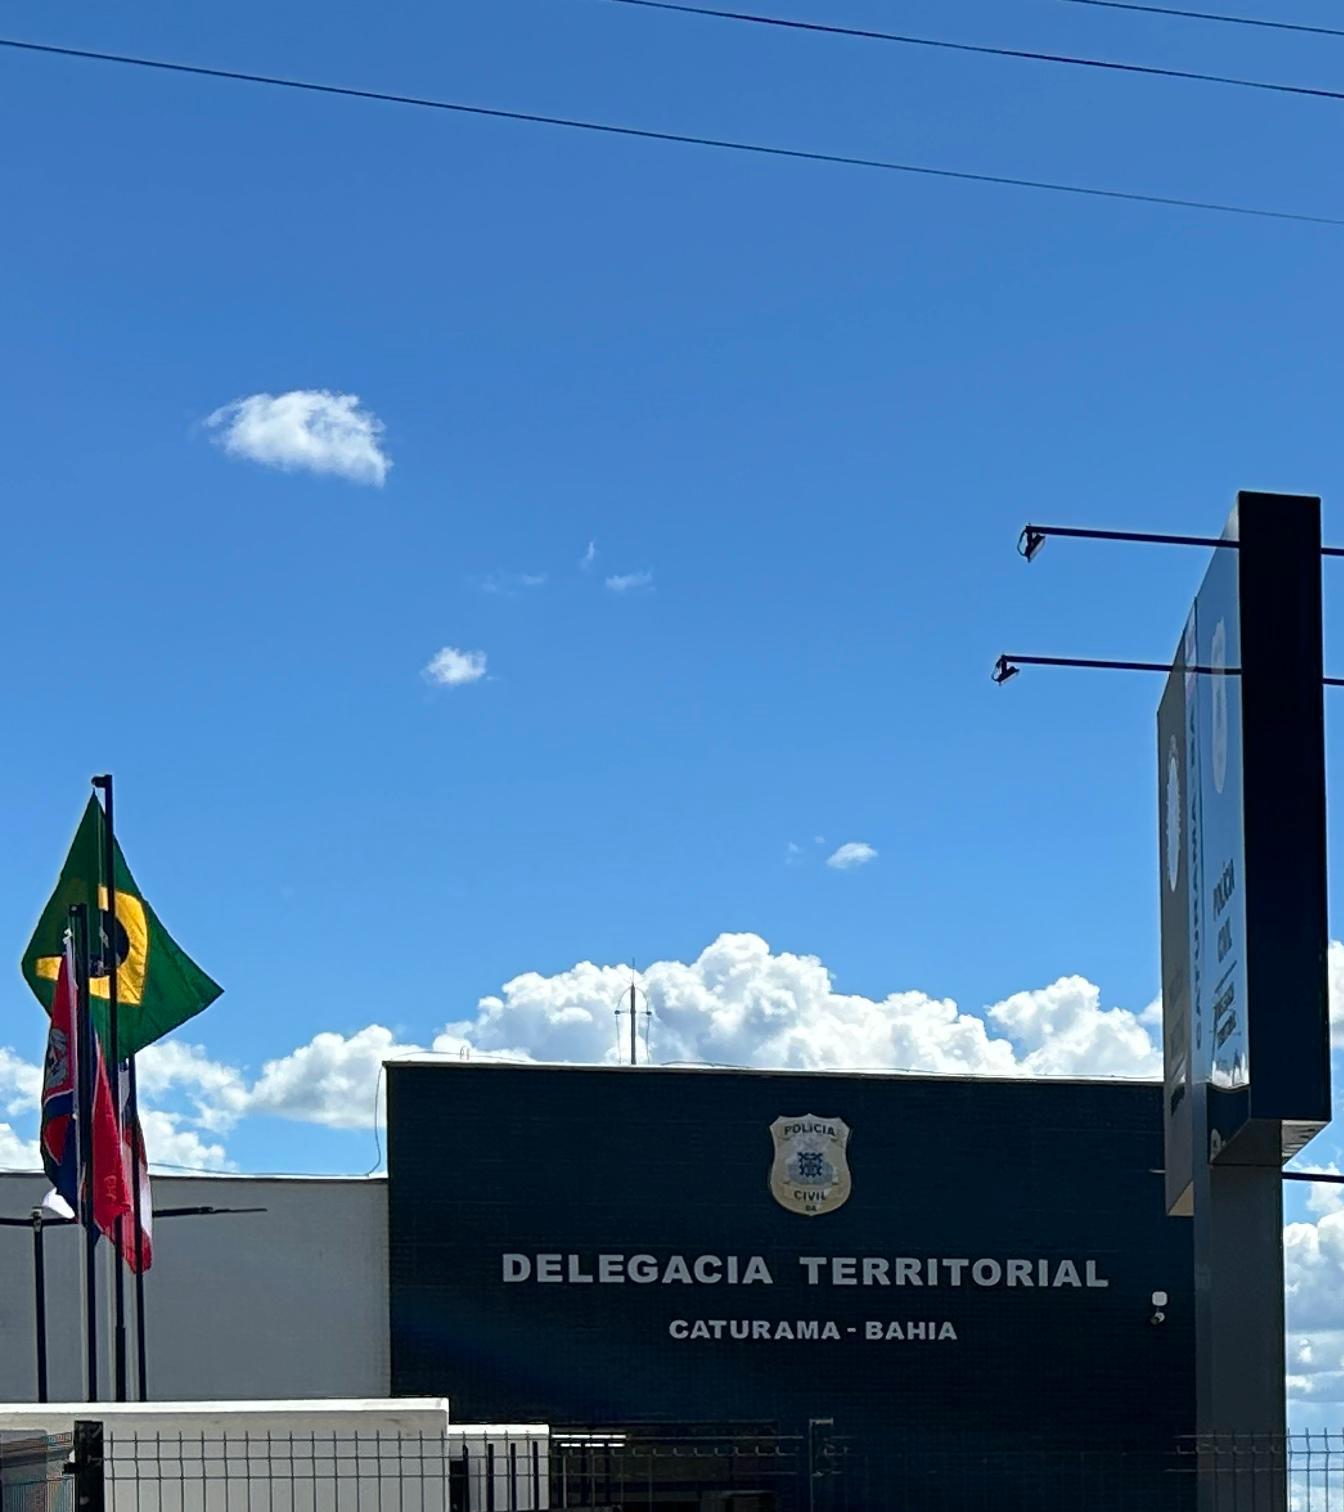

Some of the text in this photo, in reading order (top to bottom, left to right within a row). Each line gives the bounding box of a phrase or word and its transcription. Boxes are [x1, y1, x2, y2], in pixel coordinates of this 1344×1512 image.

[793, 1190, 827, 1201] CIVIL
[502, 1253, 1110, 1288] DELEGACIA TERRITORIAL
[668, 1319, 841, 1341] CATURAMA
[865, 1320, 959, 1342] BAHIA
